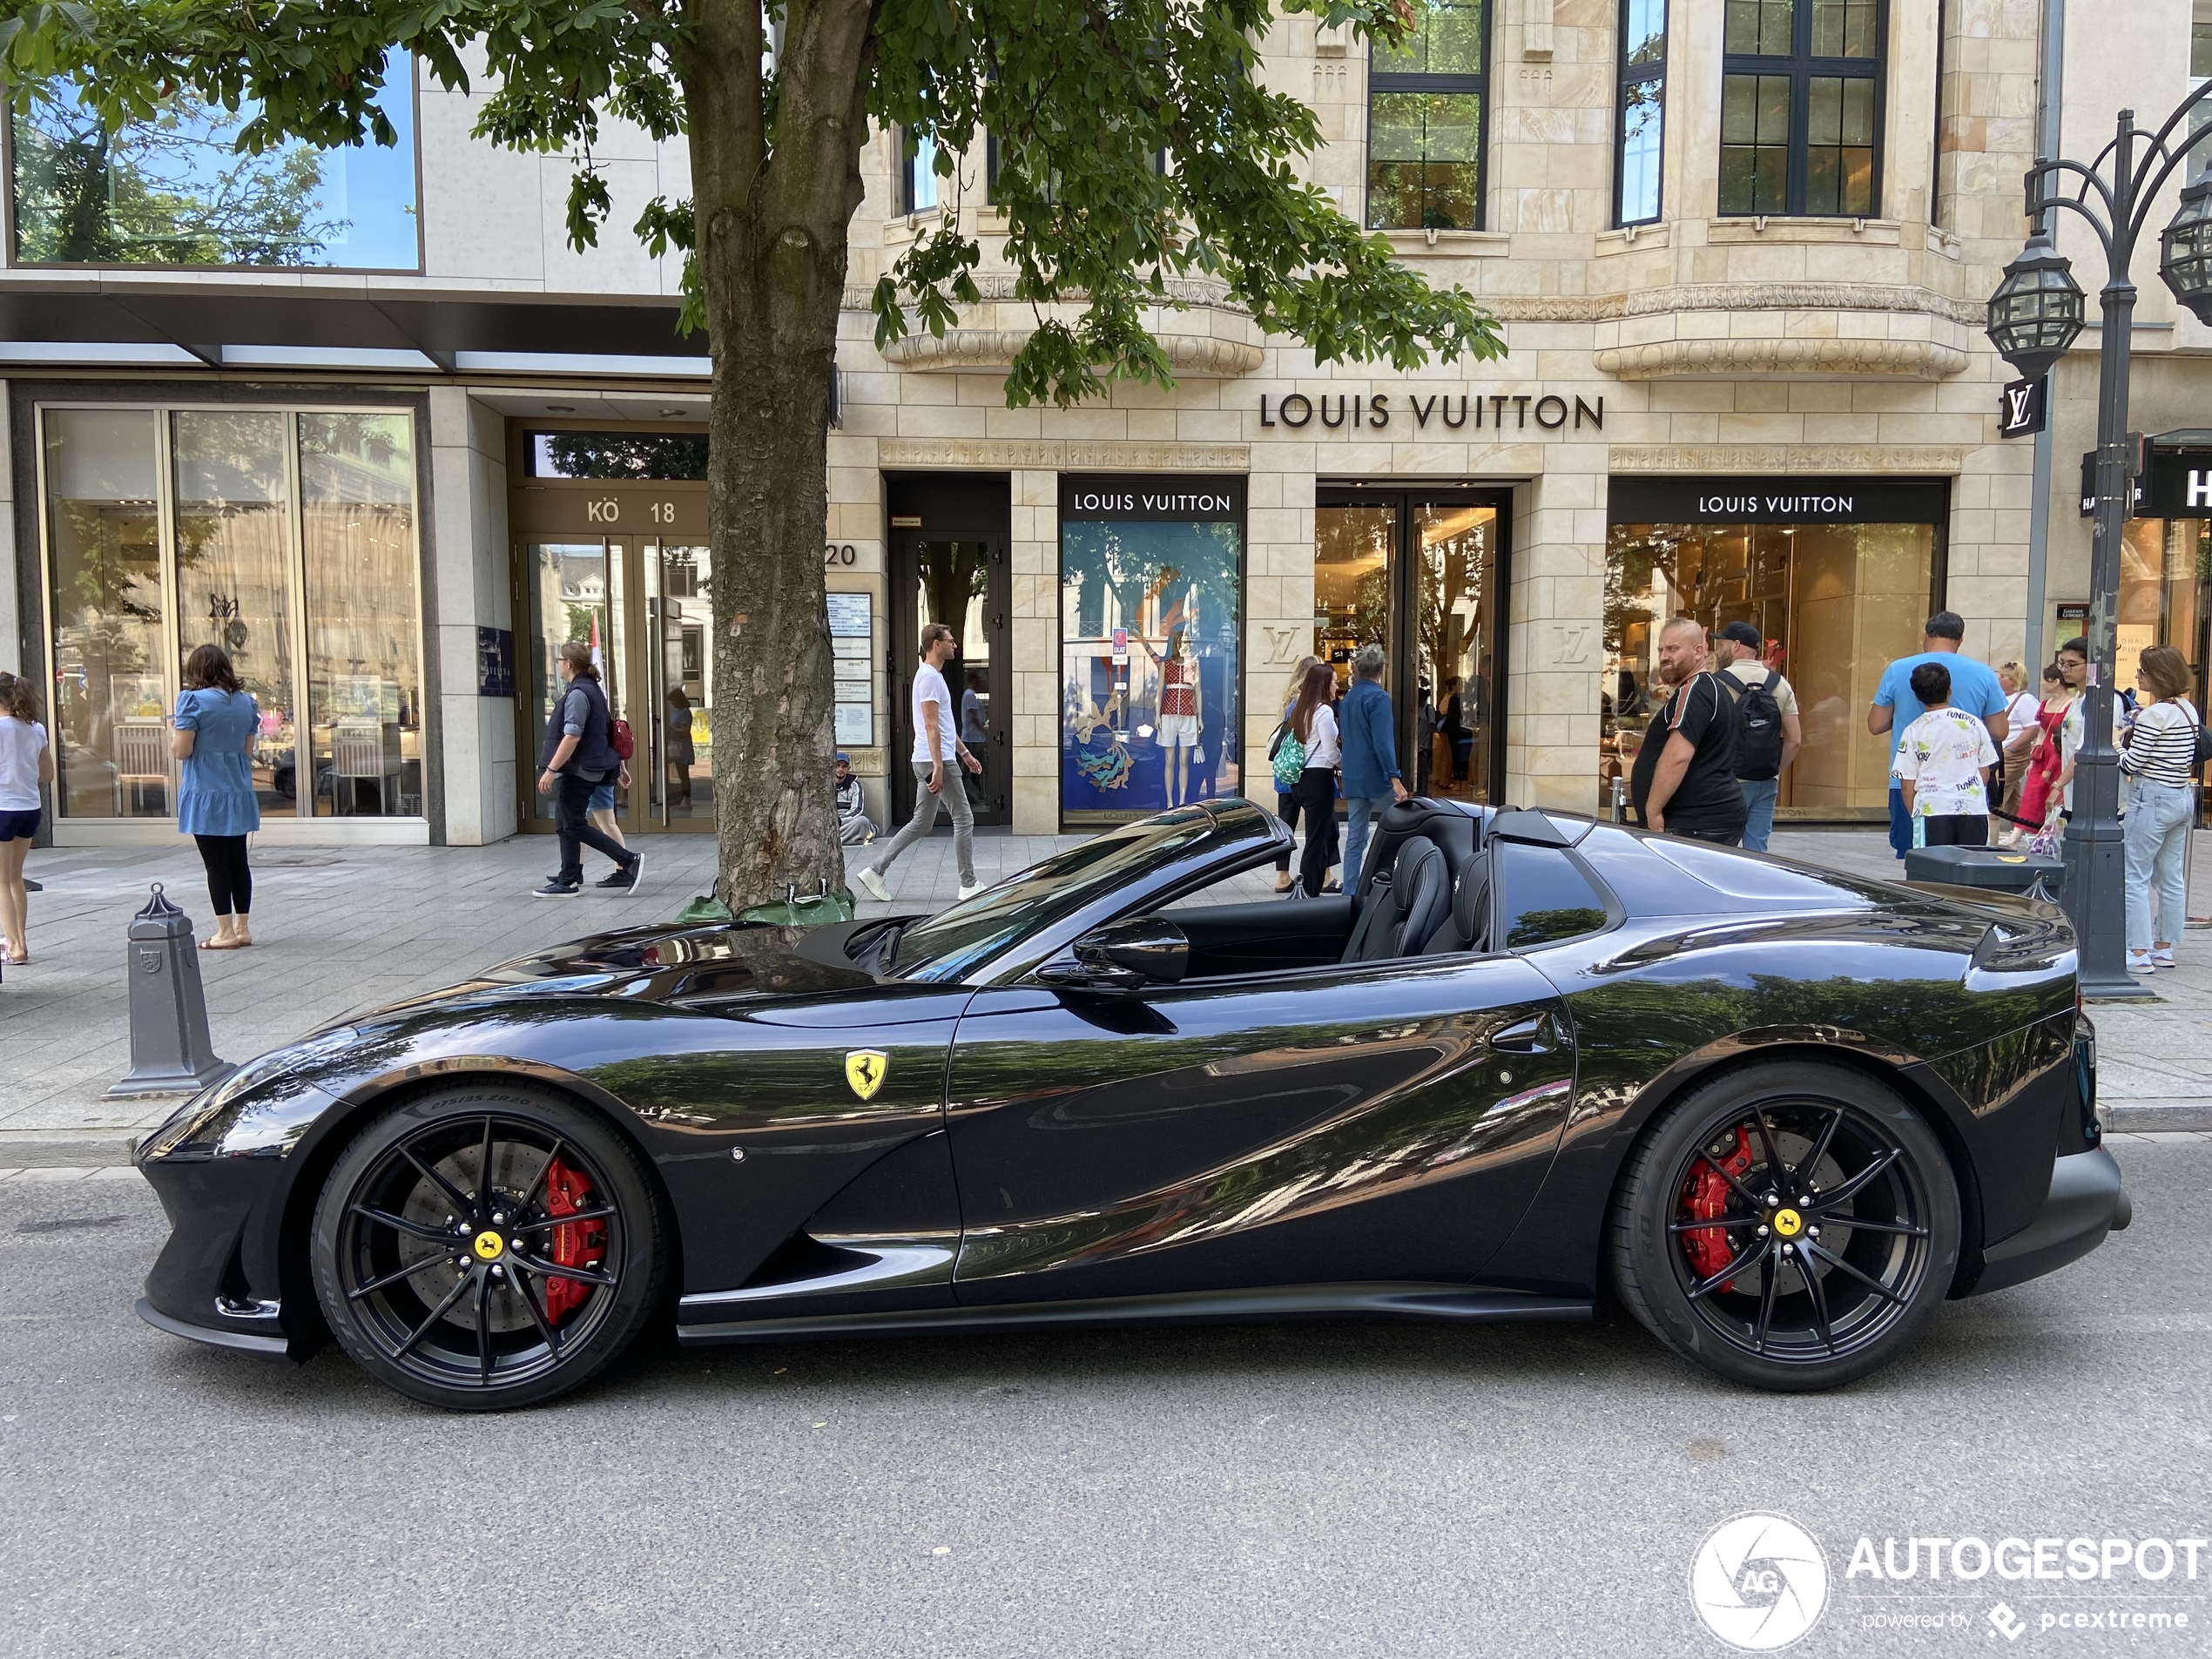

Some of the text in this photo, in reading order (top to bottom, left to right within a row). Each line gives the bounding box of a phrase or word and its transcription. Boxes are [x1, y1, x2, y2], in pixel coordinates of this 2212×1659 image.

[1260, 394, 1604, 430] LOUIS VUITTON
[588, 496, 675, 523] KÖ 18
[1075, 494, 1230, 512] LOUIS VUITTON
[1699, 496, 1852, 513] LOUIS VUITTON
[825, 544, 855, 565] 20
[430, 1094, 483, 1110] 275/35
[486, 1094, 530, 1106] ZR20
[320, 1267, 358, 1342] ZERO
